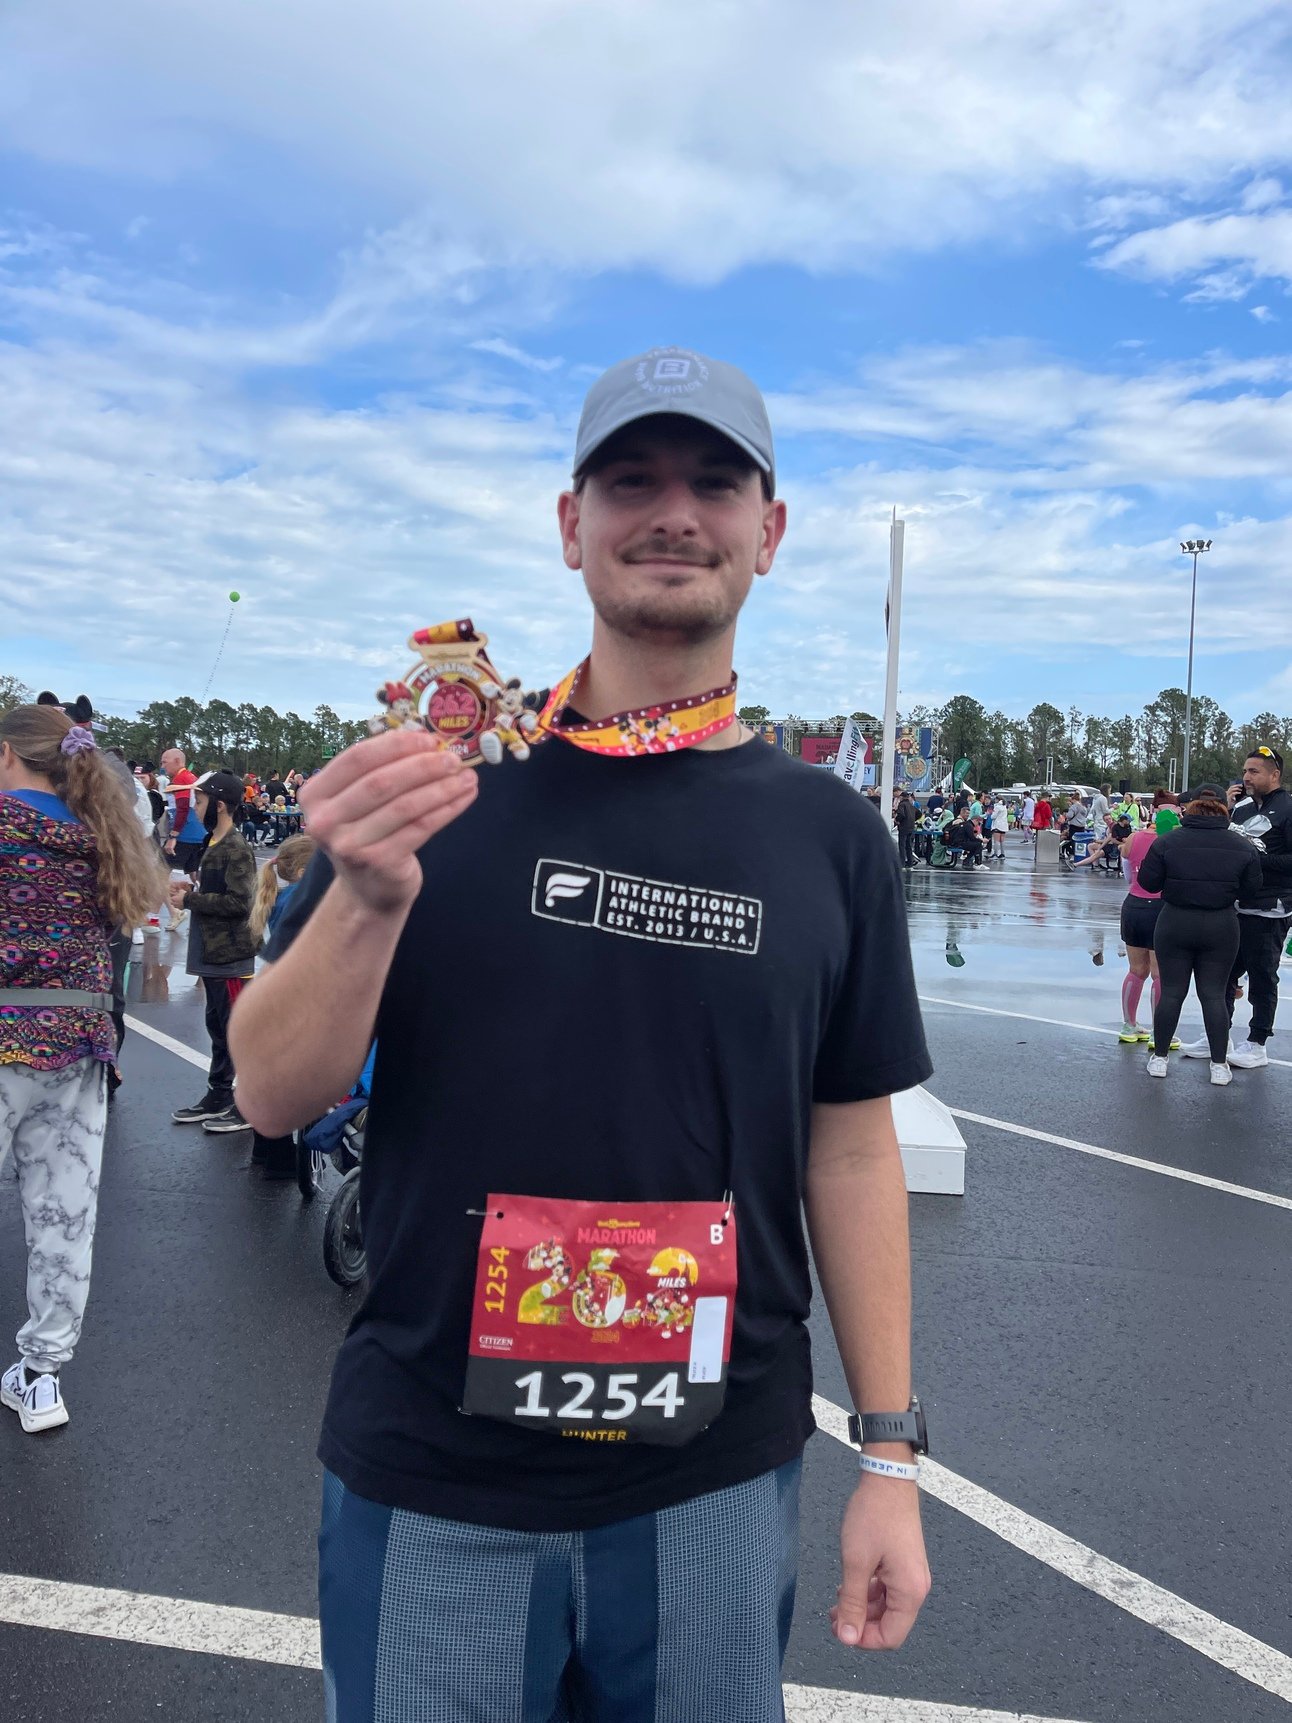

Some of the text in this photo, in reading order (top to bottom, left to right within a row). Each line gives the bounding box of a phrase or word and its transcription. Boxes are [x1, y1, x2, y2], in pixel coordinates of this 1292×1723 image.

[437, 715, 470, 729] MILES
[610, 879, 756, 919] INTERNATIONAL
[608, 896, 746, 930] ATHLETIC BRAND
[606, 912, 640, 930] EST.
[645, 919, 685, 937] 2013
[703, 929, 753, 947] U.S.A.
[576, 1227, 657, 1246] MARATHON
[710, 1224, 724, 1245] B
[483, 1246, 510, 1314] 1254
[657, 1276, 687, 1288] MILES
[479, 1335, 514, 1347] CITIZEN
[514, 1371, 685, 1421] 1254
